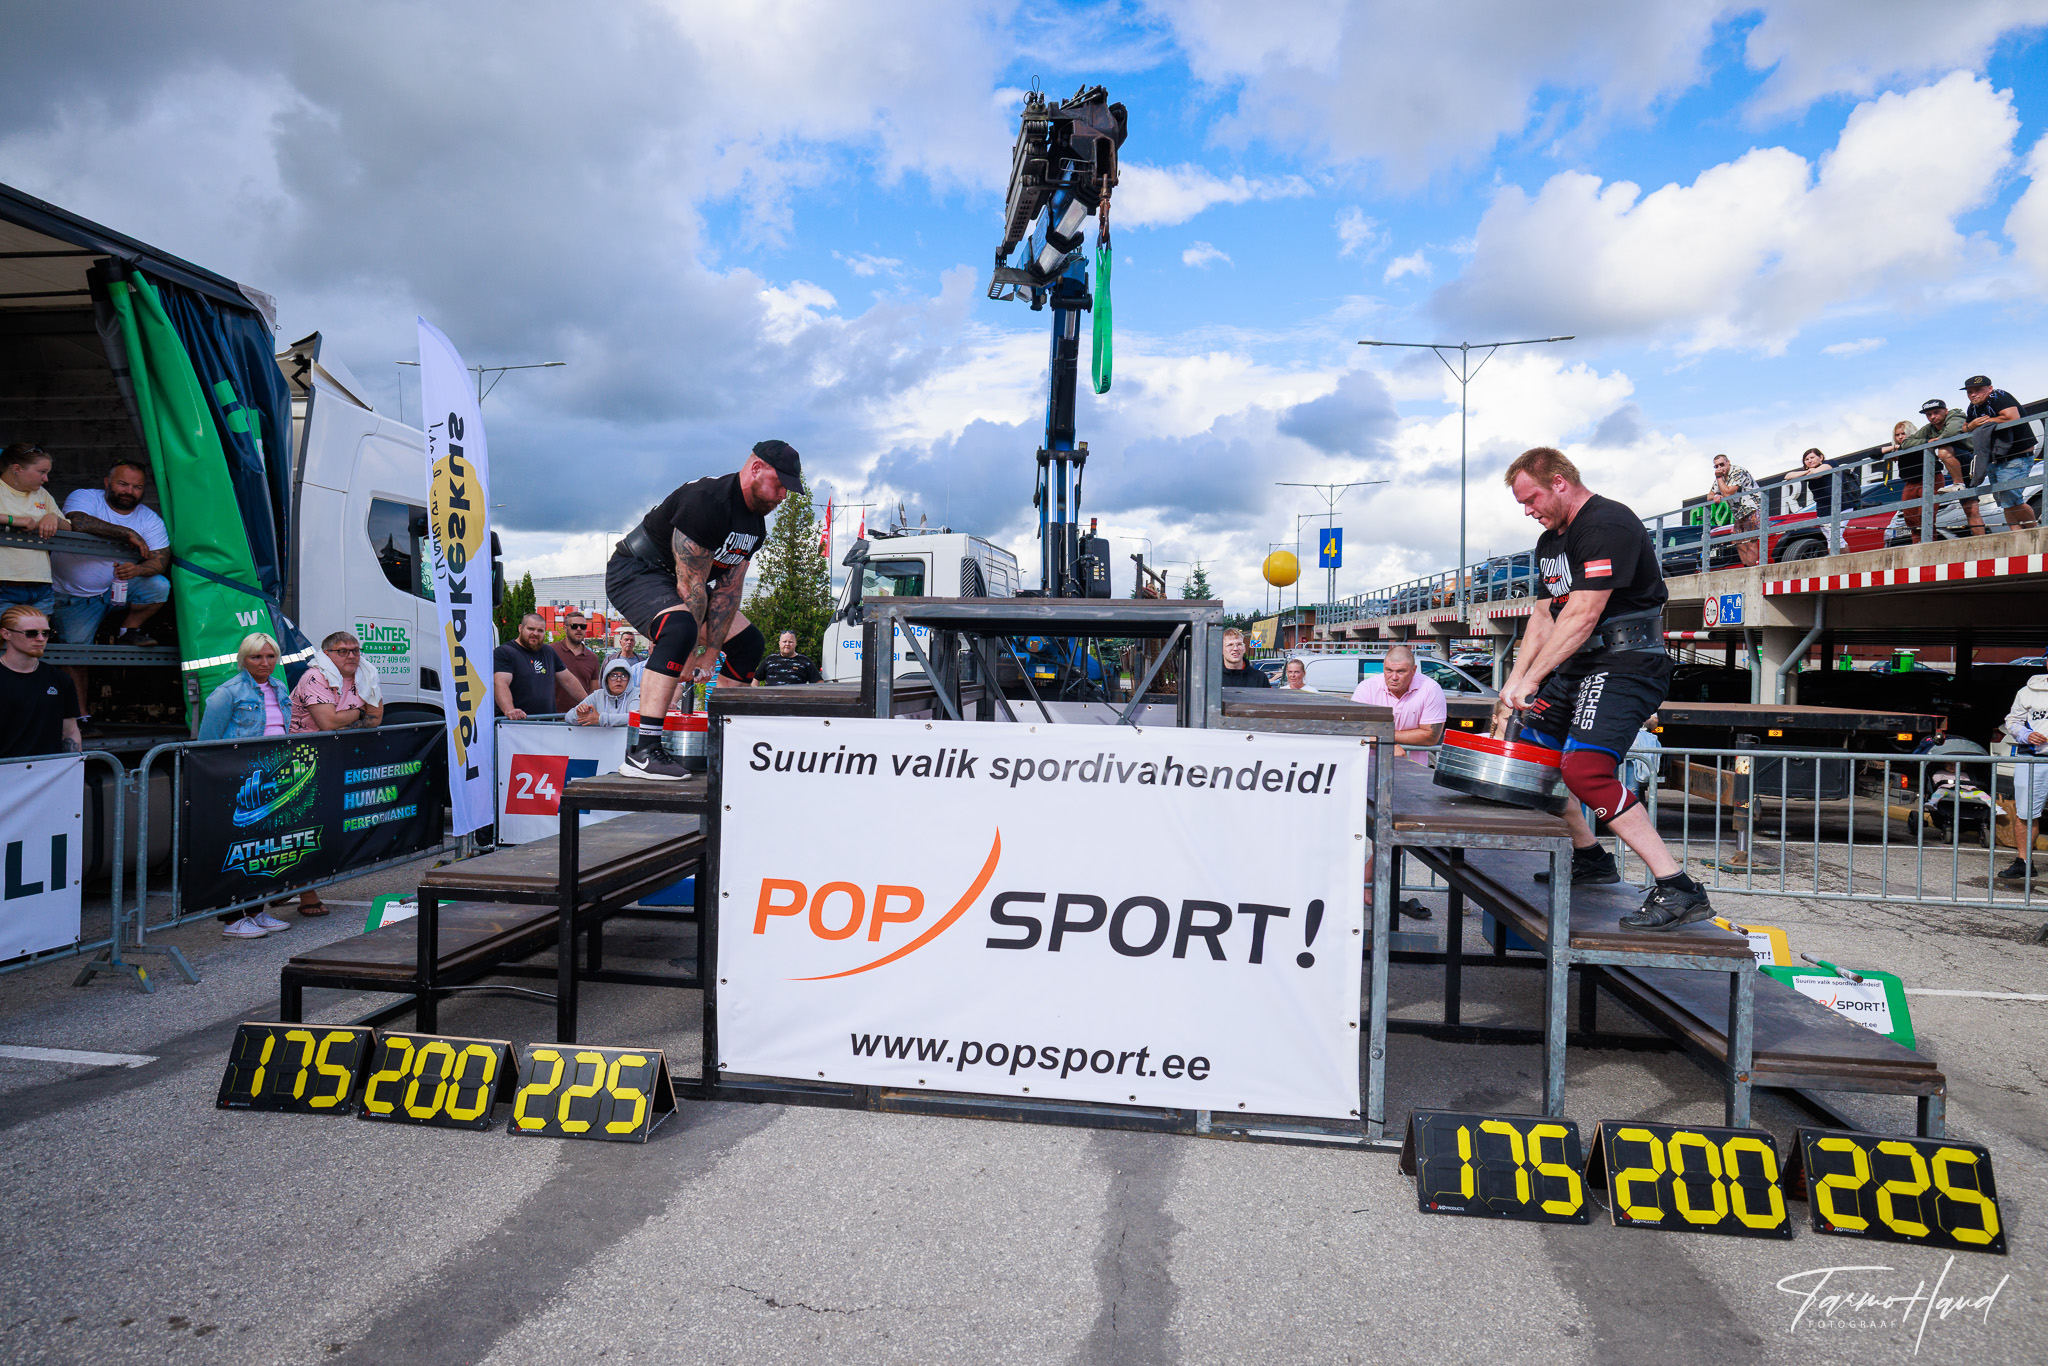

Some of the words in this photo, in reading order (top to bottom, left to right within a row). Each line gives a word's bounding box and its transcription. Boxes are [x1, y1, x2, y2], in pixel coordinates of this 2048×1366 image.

[1323, 537, 1338, 558] 4
[344, 760, 423, 785] ENGINEERING
[515, 772, 556, 801] 24
[750, 742, 878, 776] Suurim
[892, 748, 979, 779] valik
[989, 753, 1337, 795] spordivahendeid!
[344, 785, 399, 810] HUMAN
[228, 830, 315, 866] ATHLETE
[248, 850, 298, 872] BYTES
[753, 877, 926, 943] POP
[250, 1029, 356, 1108] 175
[363, 1036, 497, 1120] 200
[850, 1033, 1211, 1081] www.popsport.ee
[513, 1049, 648, 1134] 225
[1457, 1120, 1584, 1216] 175
[1615, 1127, 1786, 1229] 200
[1815, 1137, 2000, 1244] 225
